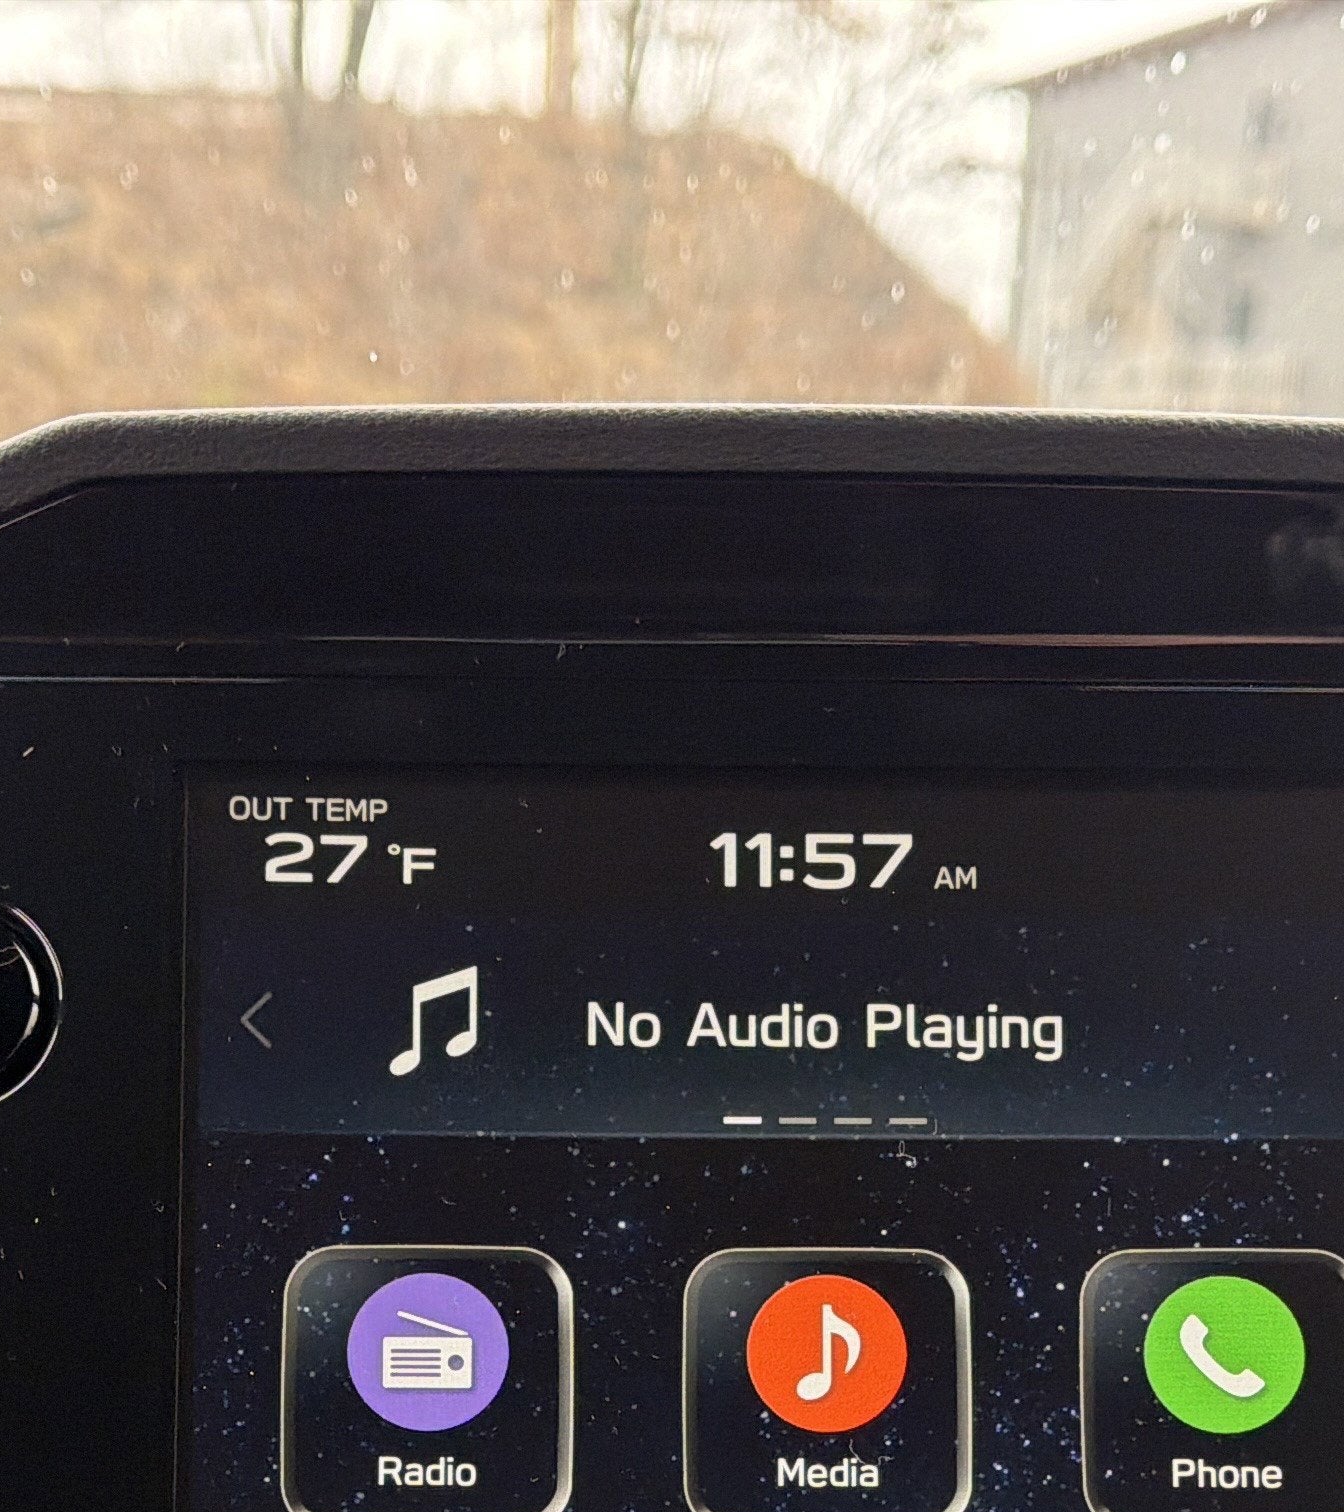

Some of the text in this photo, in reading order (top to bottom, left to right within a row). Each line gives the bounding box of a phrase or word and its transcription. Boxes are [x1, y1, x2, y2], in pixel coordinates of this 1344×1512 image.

[229, 795, 388, 823] OUT TEMP
[264, 832, 369, 884] 27
[709, 832, 977, 890] 11:57 AM
[587, 1001, 1063, 1062] No Audio Playing
[377, 1455, 477, 1487] Radio
[777, 1456, 879, 1488] Media
[1171, 1458, 1283, 1489] Phone
